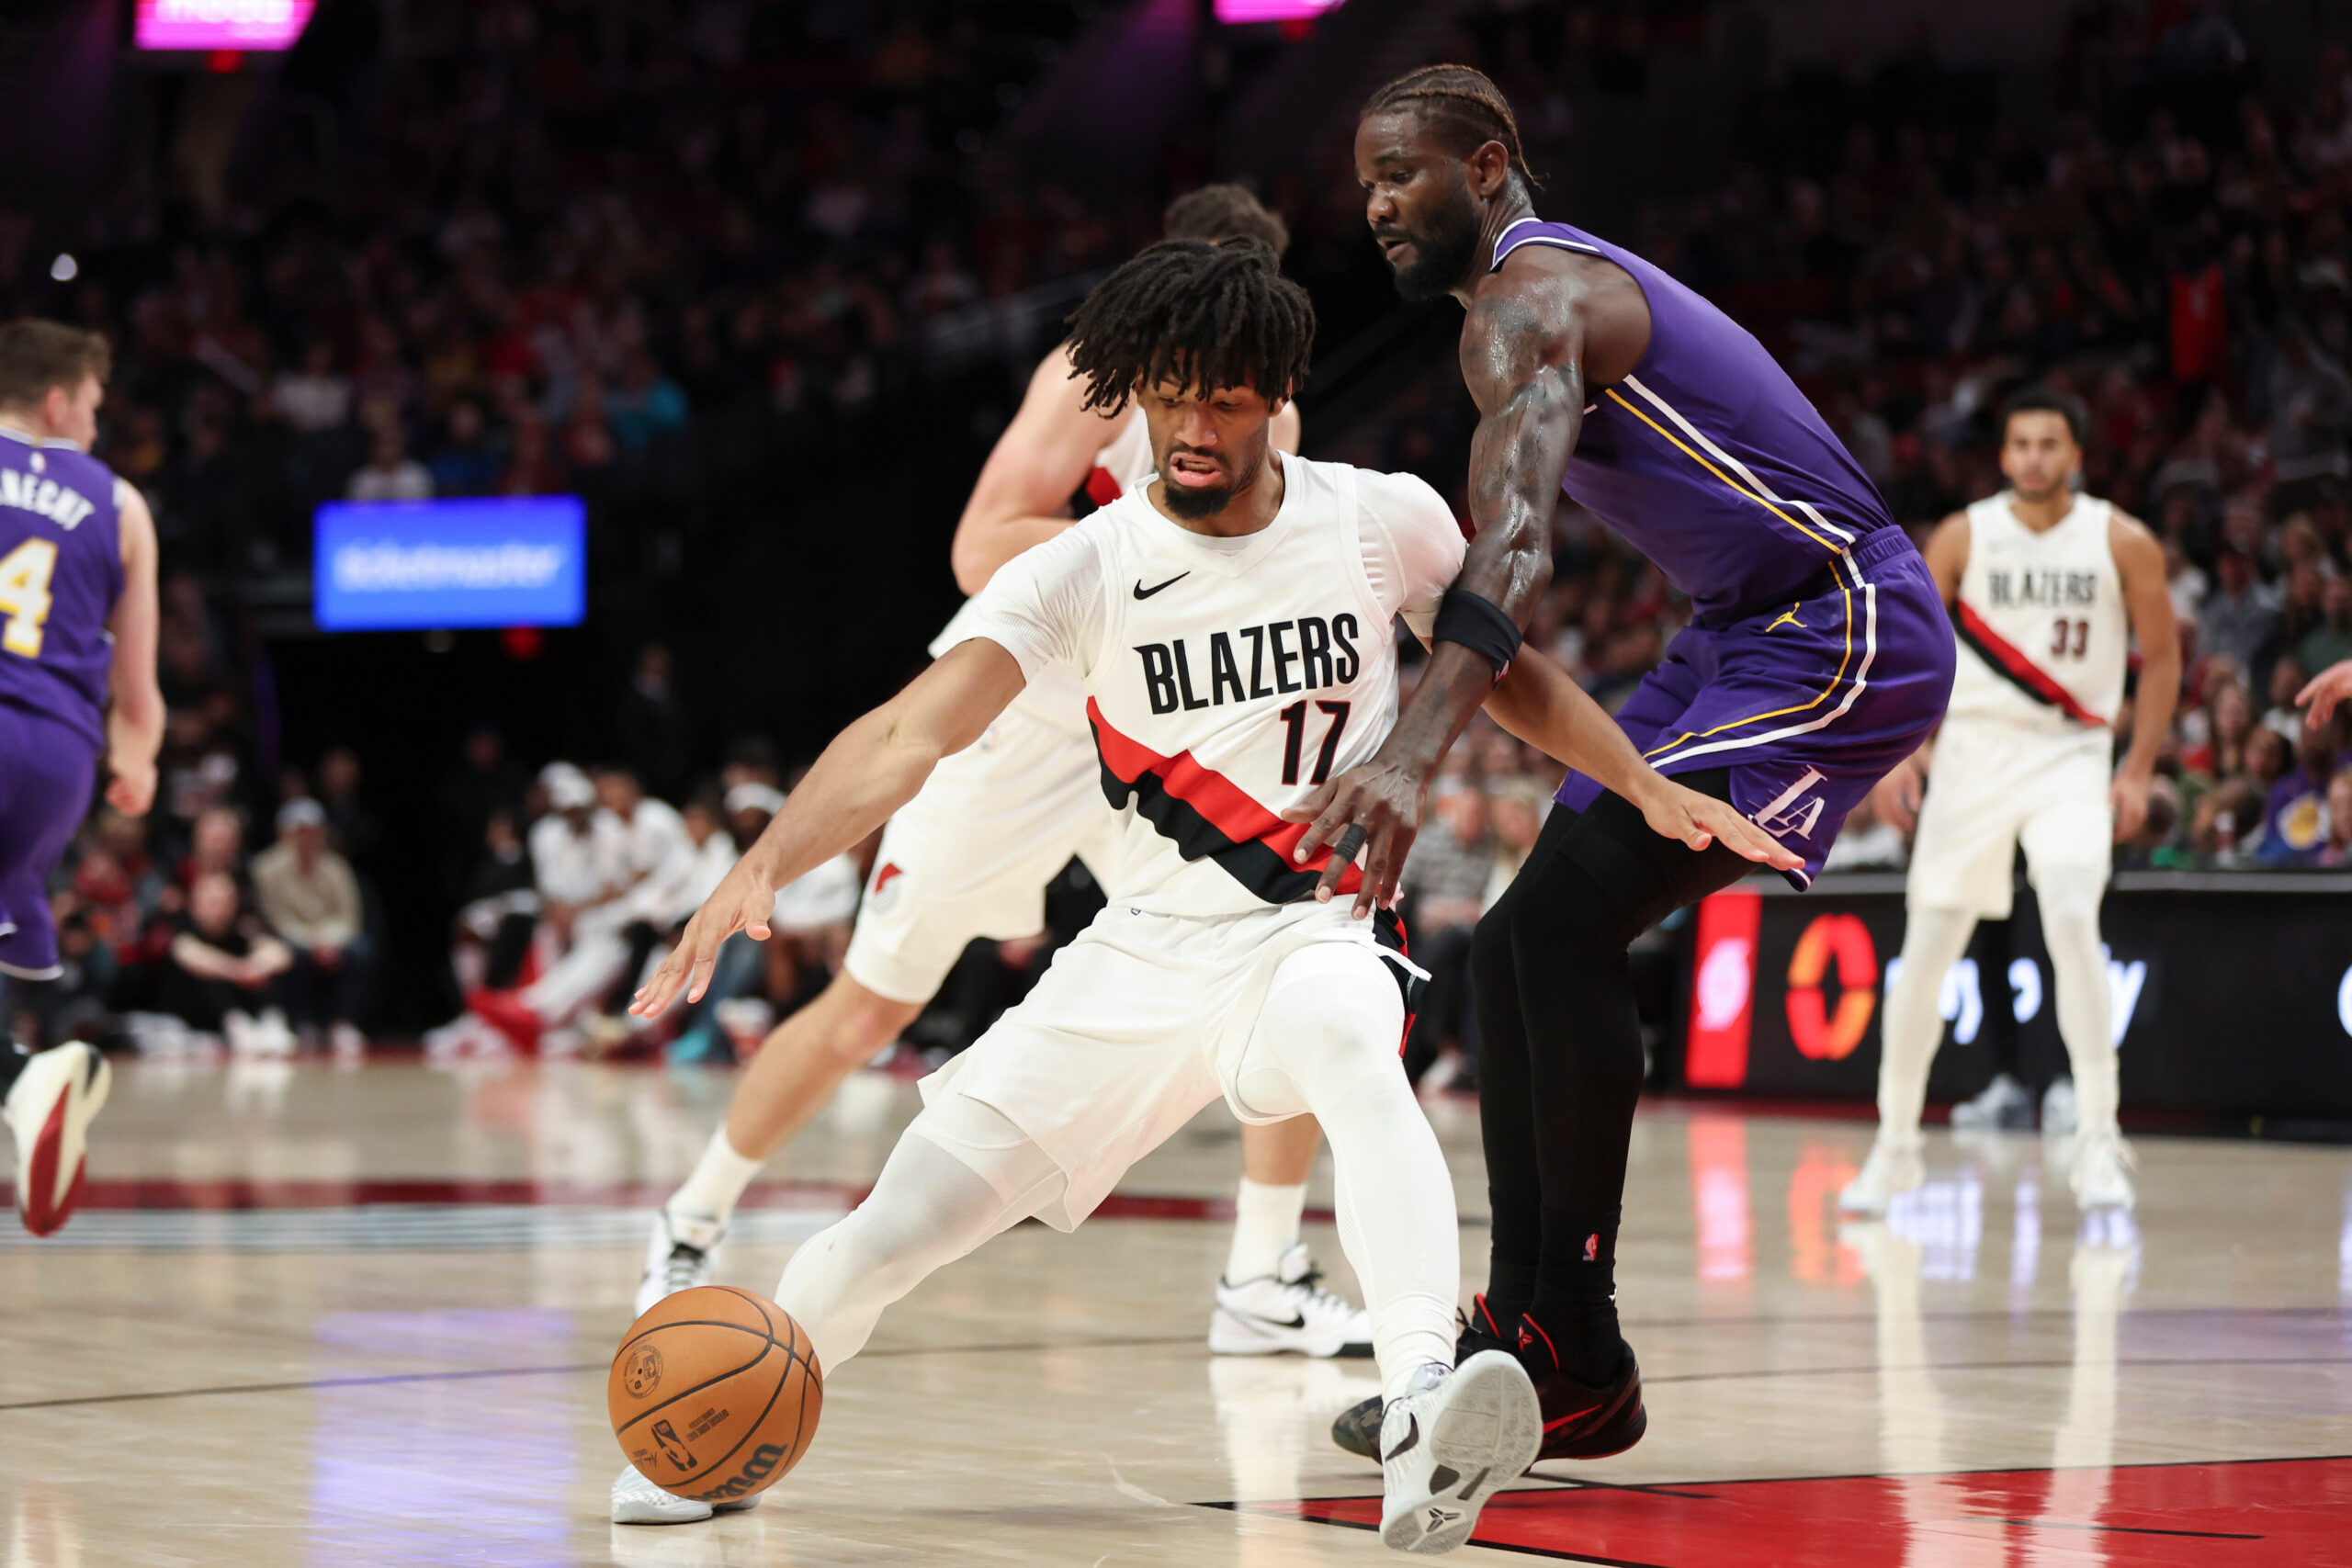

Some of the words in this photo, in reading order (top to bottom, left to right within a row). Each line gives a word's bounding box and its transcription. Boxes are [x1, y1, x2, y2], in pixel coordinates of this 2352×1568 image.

[0, 468, 96, 531] NECHT
[0, 536, 58, 659] 4
[1989, 569, 2097, 608] BLAZERS
[1133, 613, 1360, 715] BLAZERS
[2050, 617, 2090, 661] 33
[1280, 699, 1351, 785] 17
